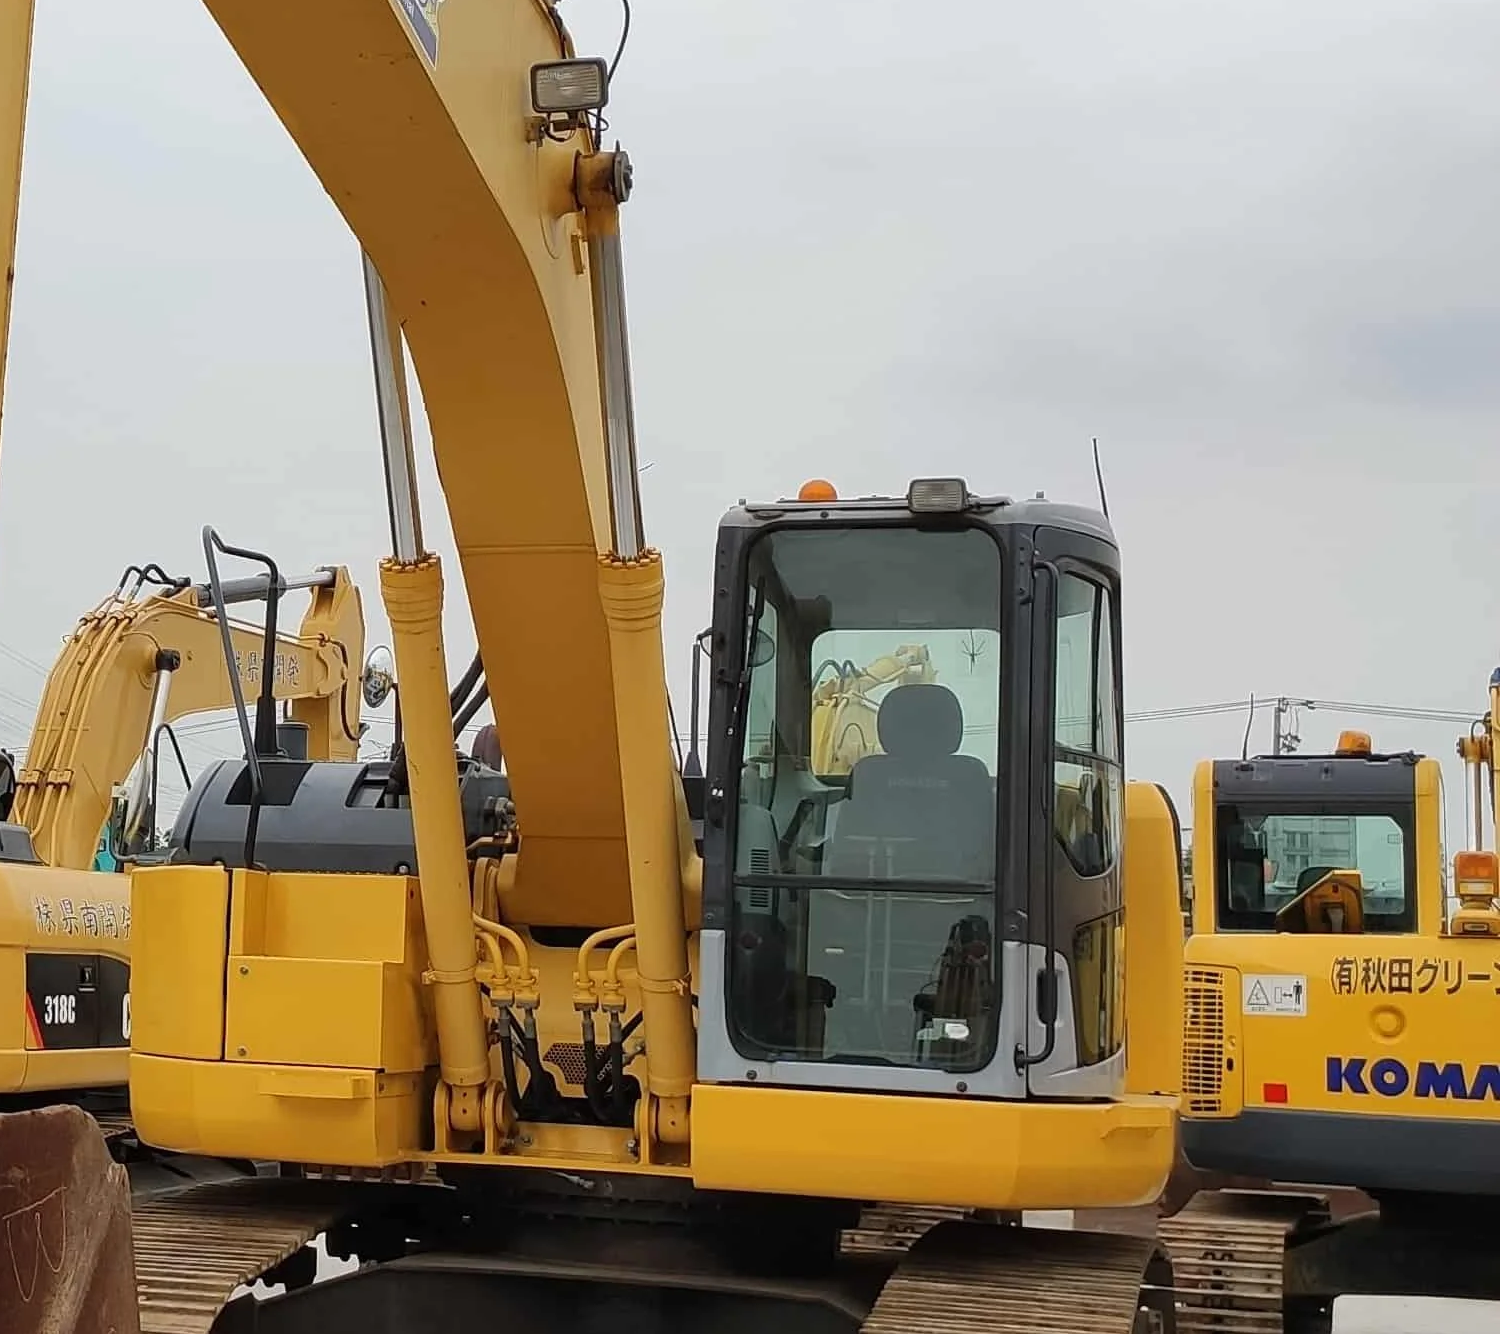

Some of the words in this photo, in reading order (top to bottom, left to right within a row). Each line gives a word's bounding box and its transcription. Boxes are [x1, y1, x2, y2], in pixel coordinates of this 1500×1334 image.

[1331, 956, 1500, 995] (有)秋田グリー
[44, 994, 76, 1025] 318C
